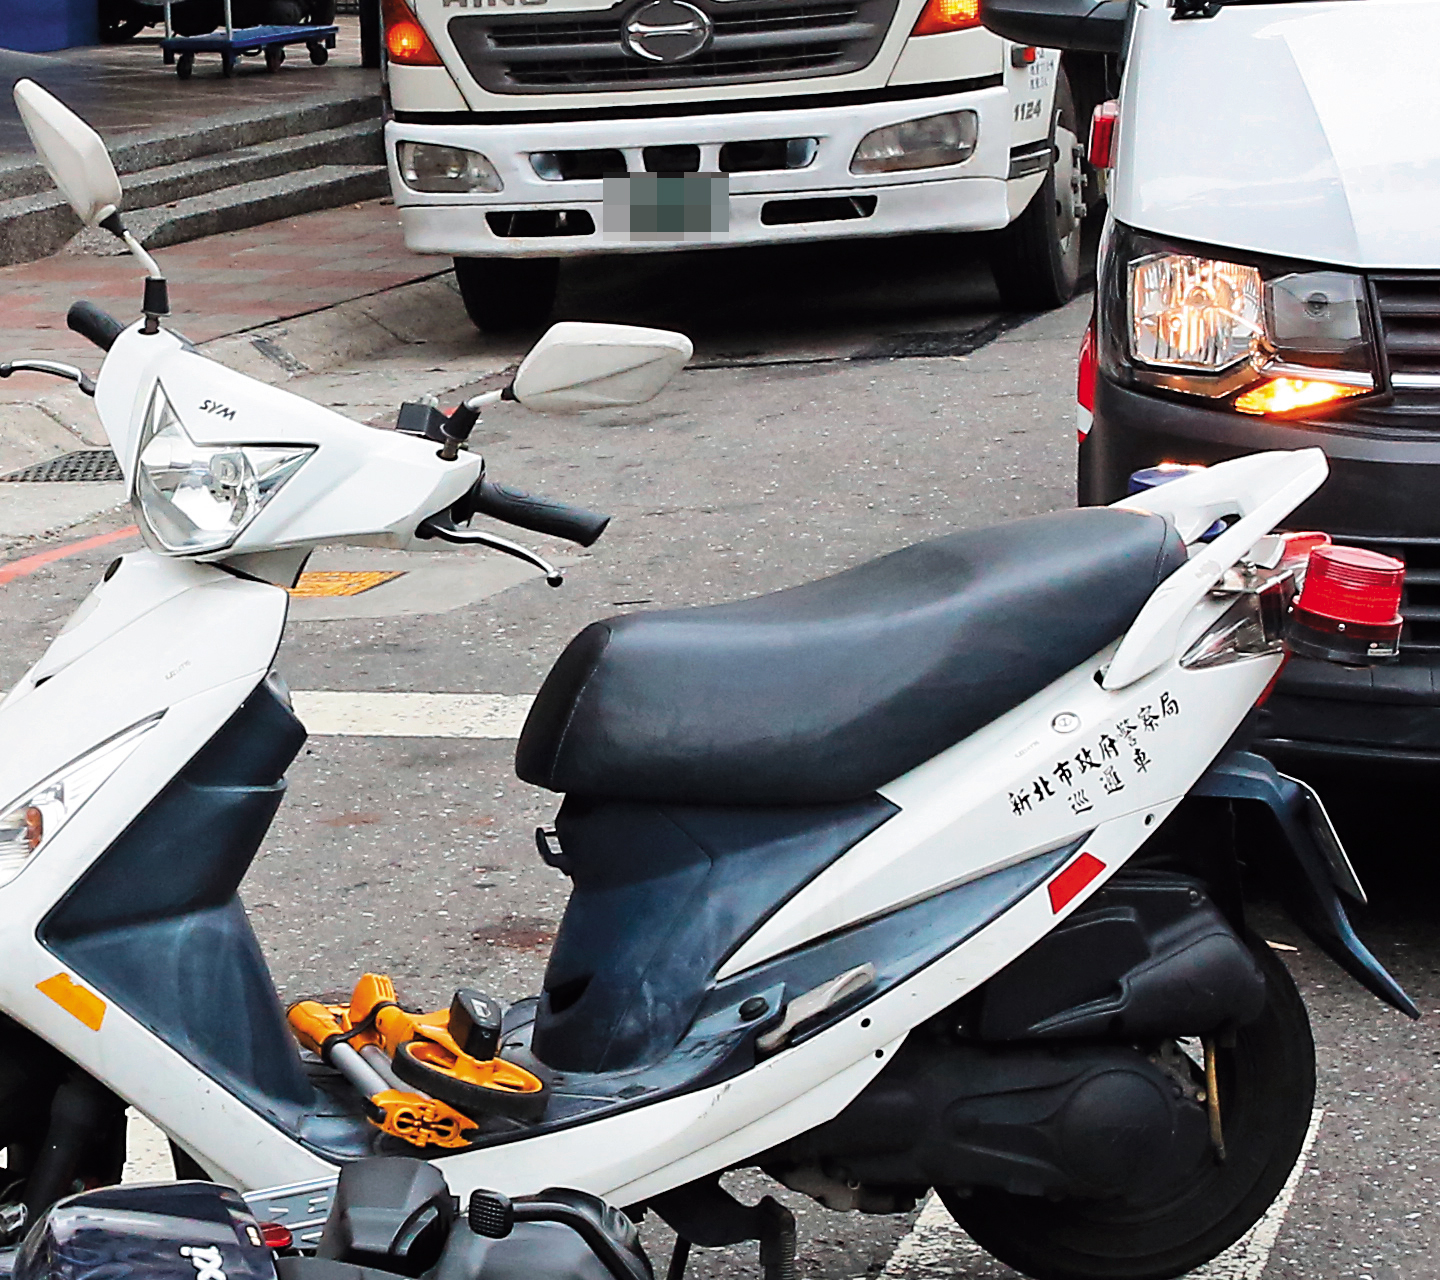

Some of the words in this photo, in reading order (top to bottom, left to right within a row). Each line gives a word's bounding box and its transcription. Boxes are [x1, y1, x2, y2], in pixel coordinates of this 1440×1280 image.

[1013, 100, 1042, 122] 1124
[199, 399, 236, 421] SYM
[1008, 691, 1180, 816] 新北市政府警察局
